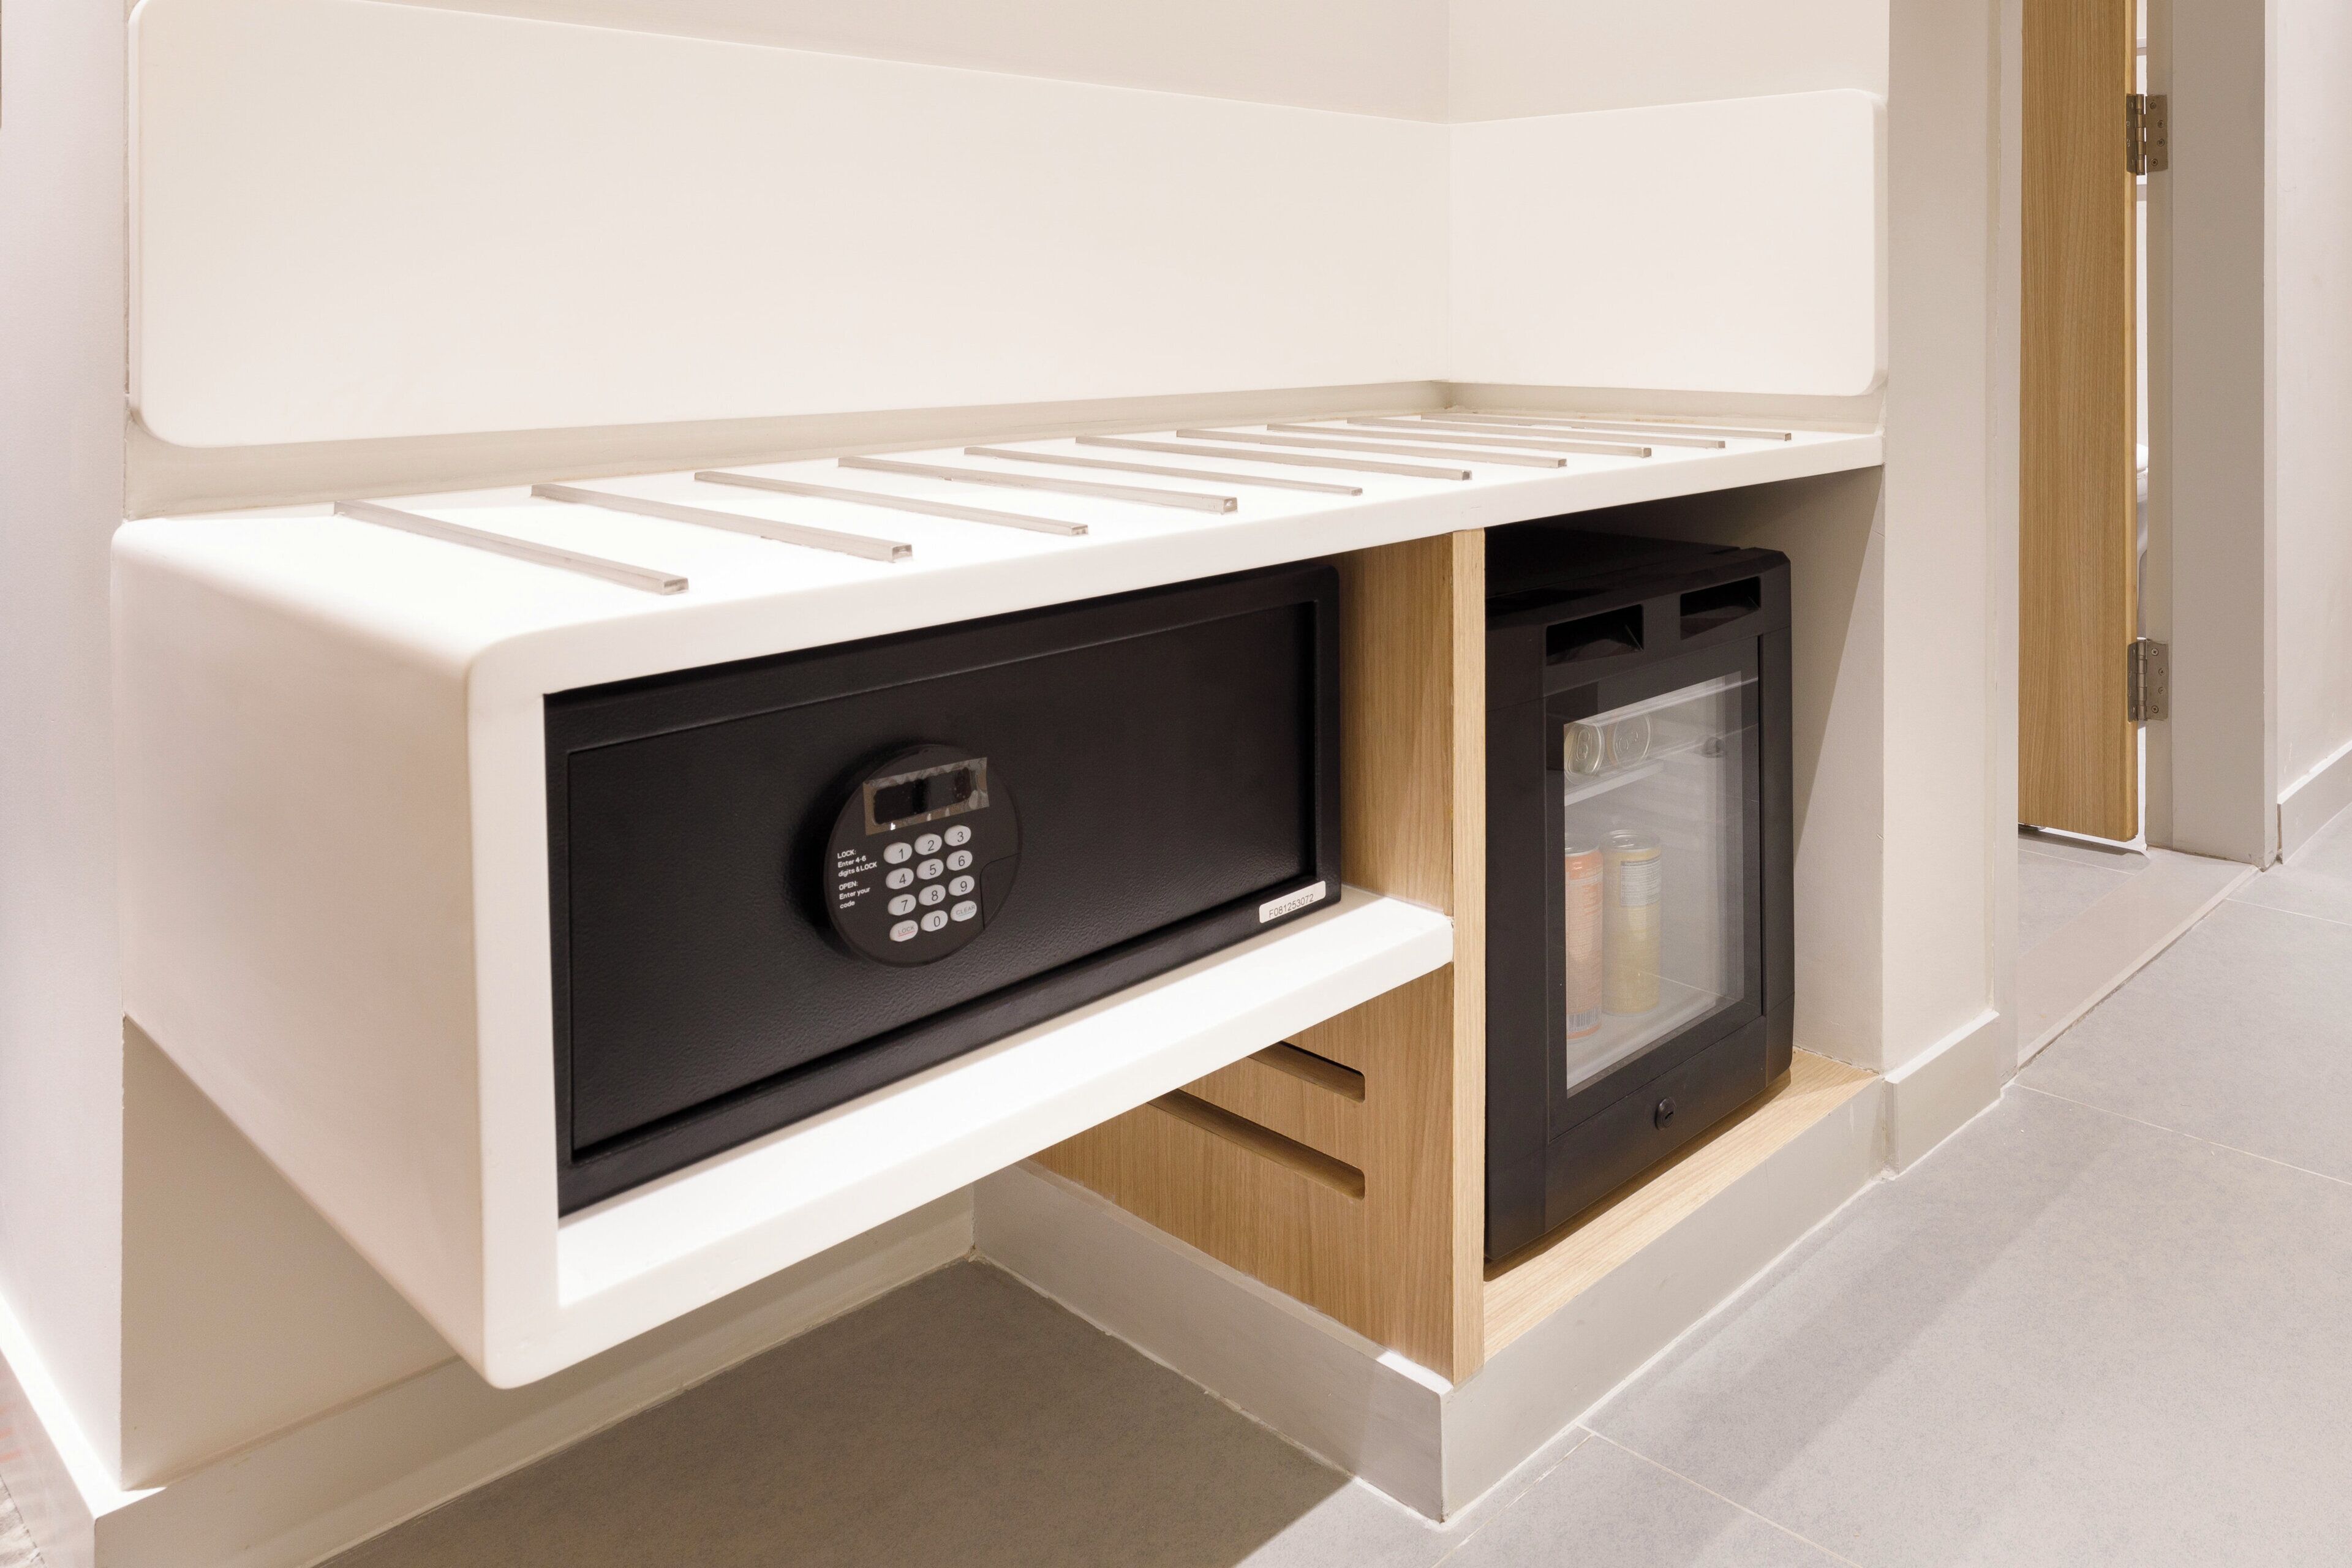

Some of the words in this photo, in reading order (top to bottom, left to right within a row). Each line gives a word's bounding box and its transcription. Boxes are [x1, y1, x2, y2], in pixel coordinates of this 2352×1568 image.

[899, 849, 903, 859] 1
[927, 840, 935, 851] 2
[957, 831, 964, 842] 3
[837, 849, 856, 859] LOCK:
[837, 859, 854, 868] Enter
[838, 869, 855, 877] digits
[860, 861, 877, 871] LOCK
[899, 873, 907, 884] 4
[929, 864, 937, 875] 5
[958, 855, 965, 867] 6
[839, 881, 858, 891] OPEN:
[839, 891, 856, 900] Enter
[857, 887, 870, 897] your
[901, 899, 908, 911] 7
[931, 890, 938, 902] 8
[960, 881, 967, 892] 9
[840, 900, 855, 909] code
[1268, 893, 1314, 918] F081253072
[897, 926, 915, 935] LOCK
[933, 916, 941, 927] 0
[956, 904, 976, 915] CLEAR
